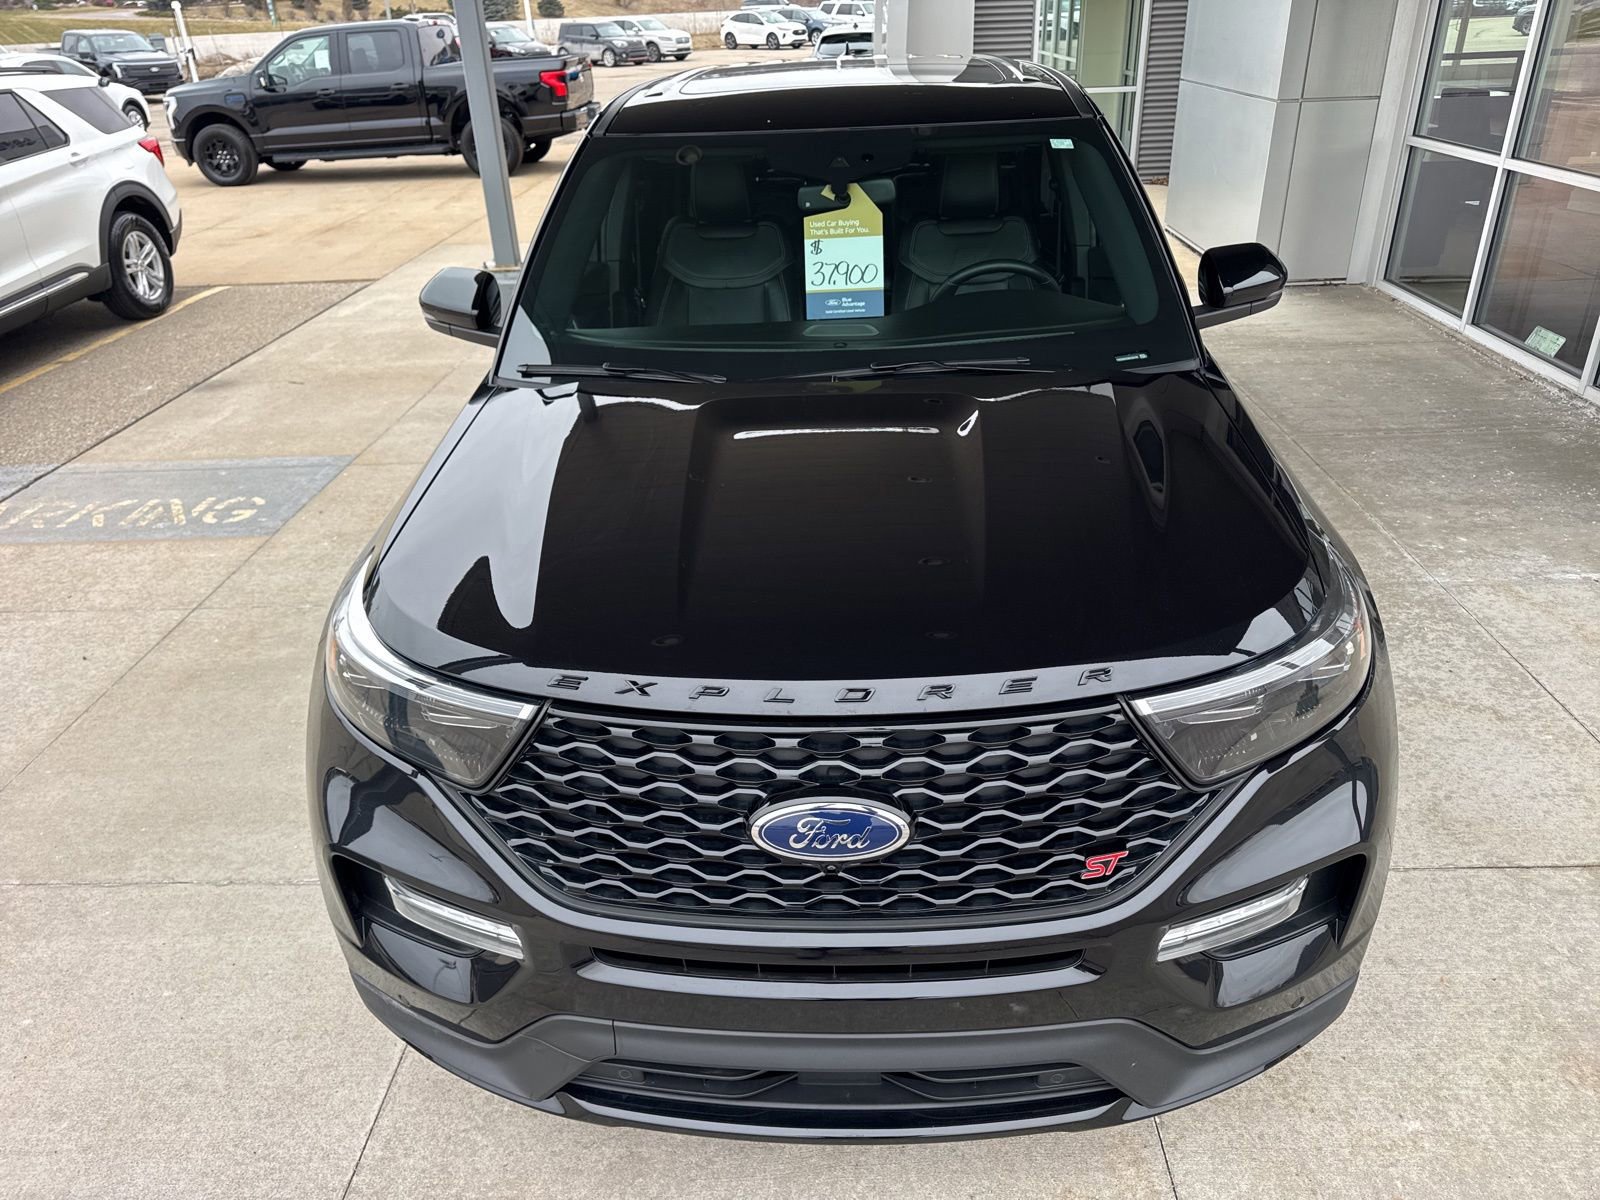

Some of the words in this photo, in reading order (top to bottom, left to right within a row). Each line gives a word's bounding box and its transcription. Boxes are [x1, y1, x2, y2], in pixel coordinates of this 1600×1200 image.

[809, 220, 826, 228] Used
[826, 220, 838, 228] Car
[838, 219, 860, 228] Buying
[809, 228, 829, 236] That's
[829, 227, 844, 235] Built
[810, 239, 824, 255] $
[547, 665, 1114, 703] EXPLORER
[788, 817, 872, 849] Ford
[1081, 850, 1129, 880] ST
